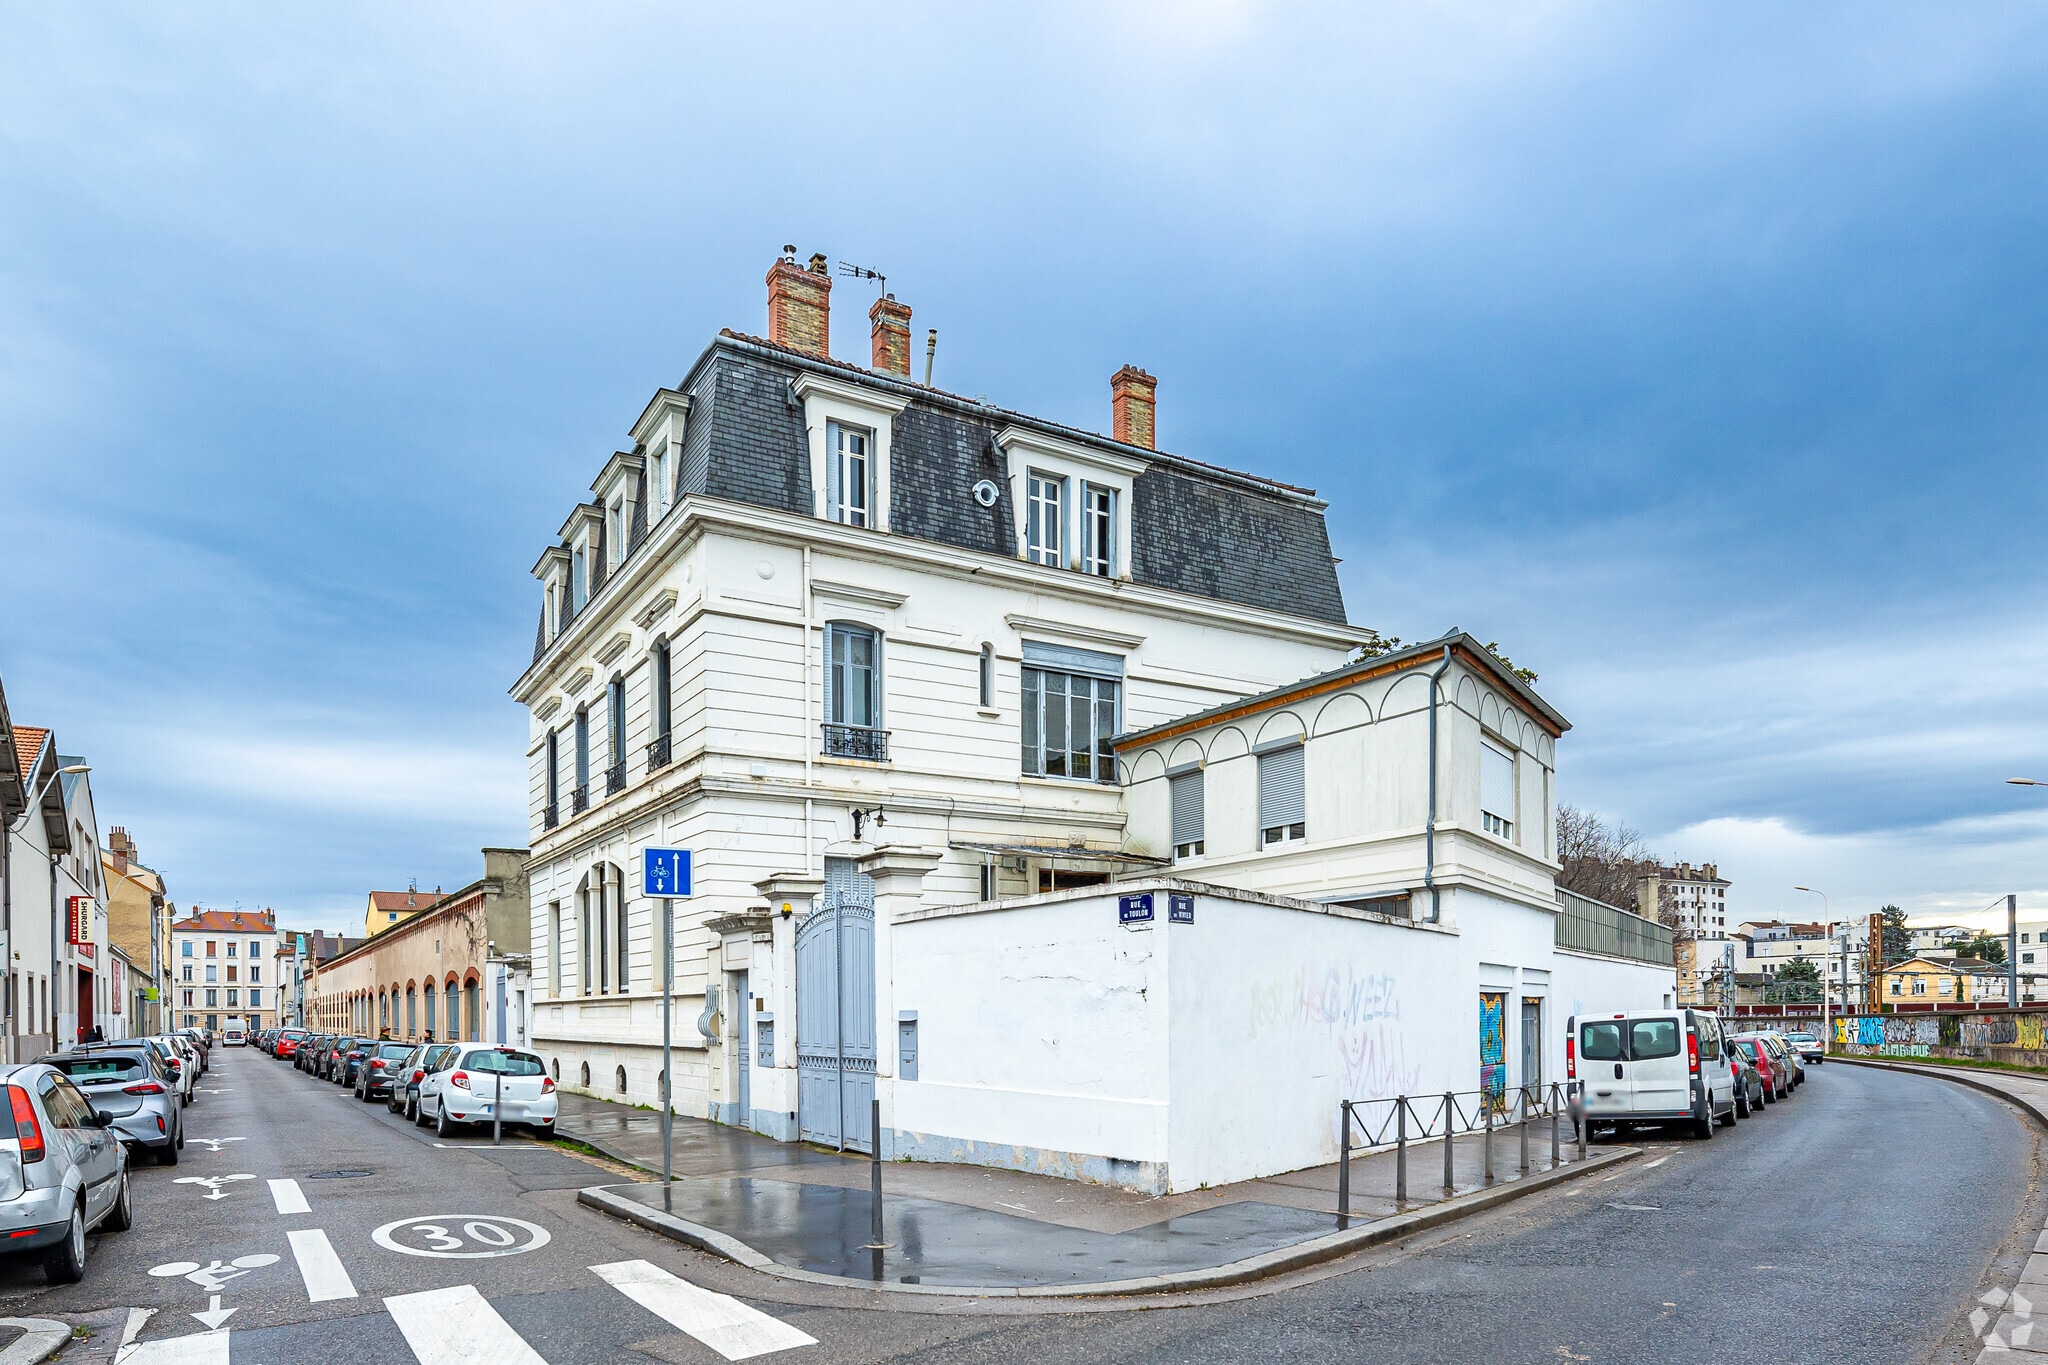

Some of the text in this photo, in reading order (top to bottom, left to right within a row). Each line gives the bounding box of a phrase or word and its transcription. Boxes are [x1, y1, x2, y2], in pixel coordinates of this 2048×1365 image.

[1130, 901, 1141, 909] RUE
[1178, 902, 1187, 910] RUE
[1129, 909, 1149, 918] TOULON
[411, 1221, 516, 1251] 30
